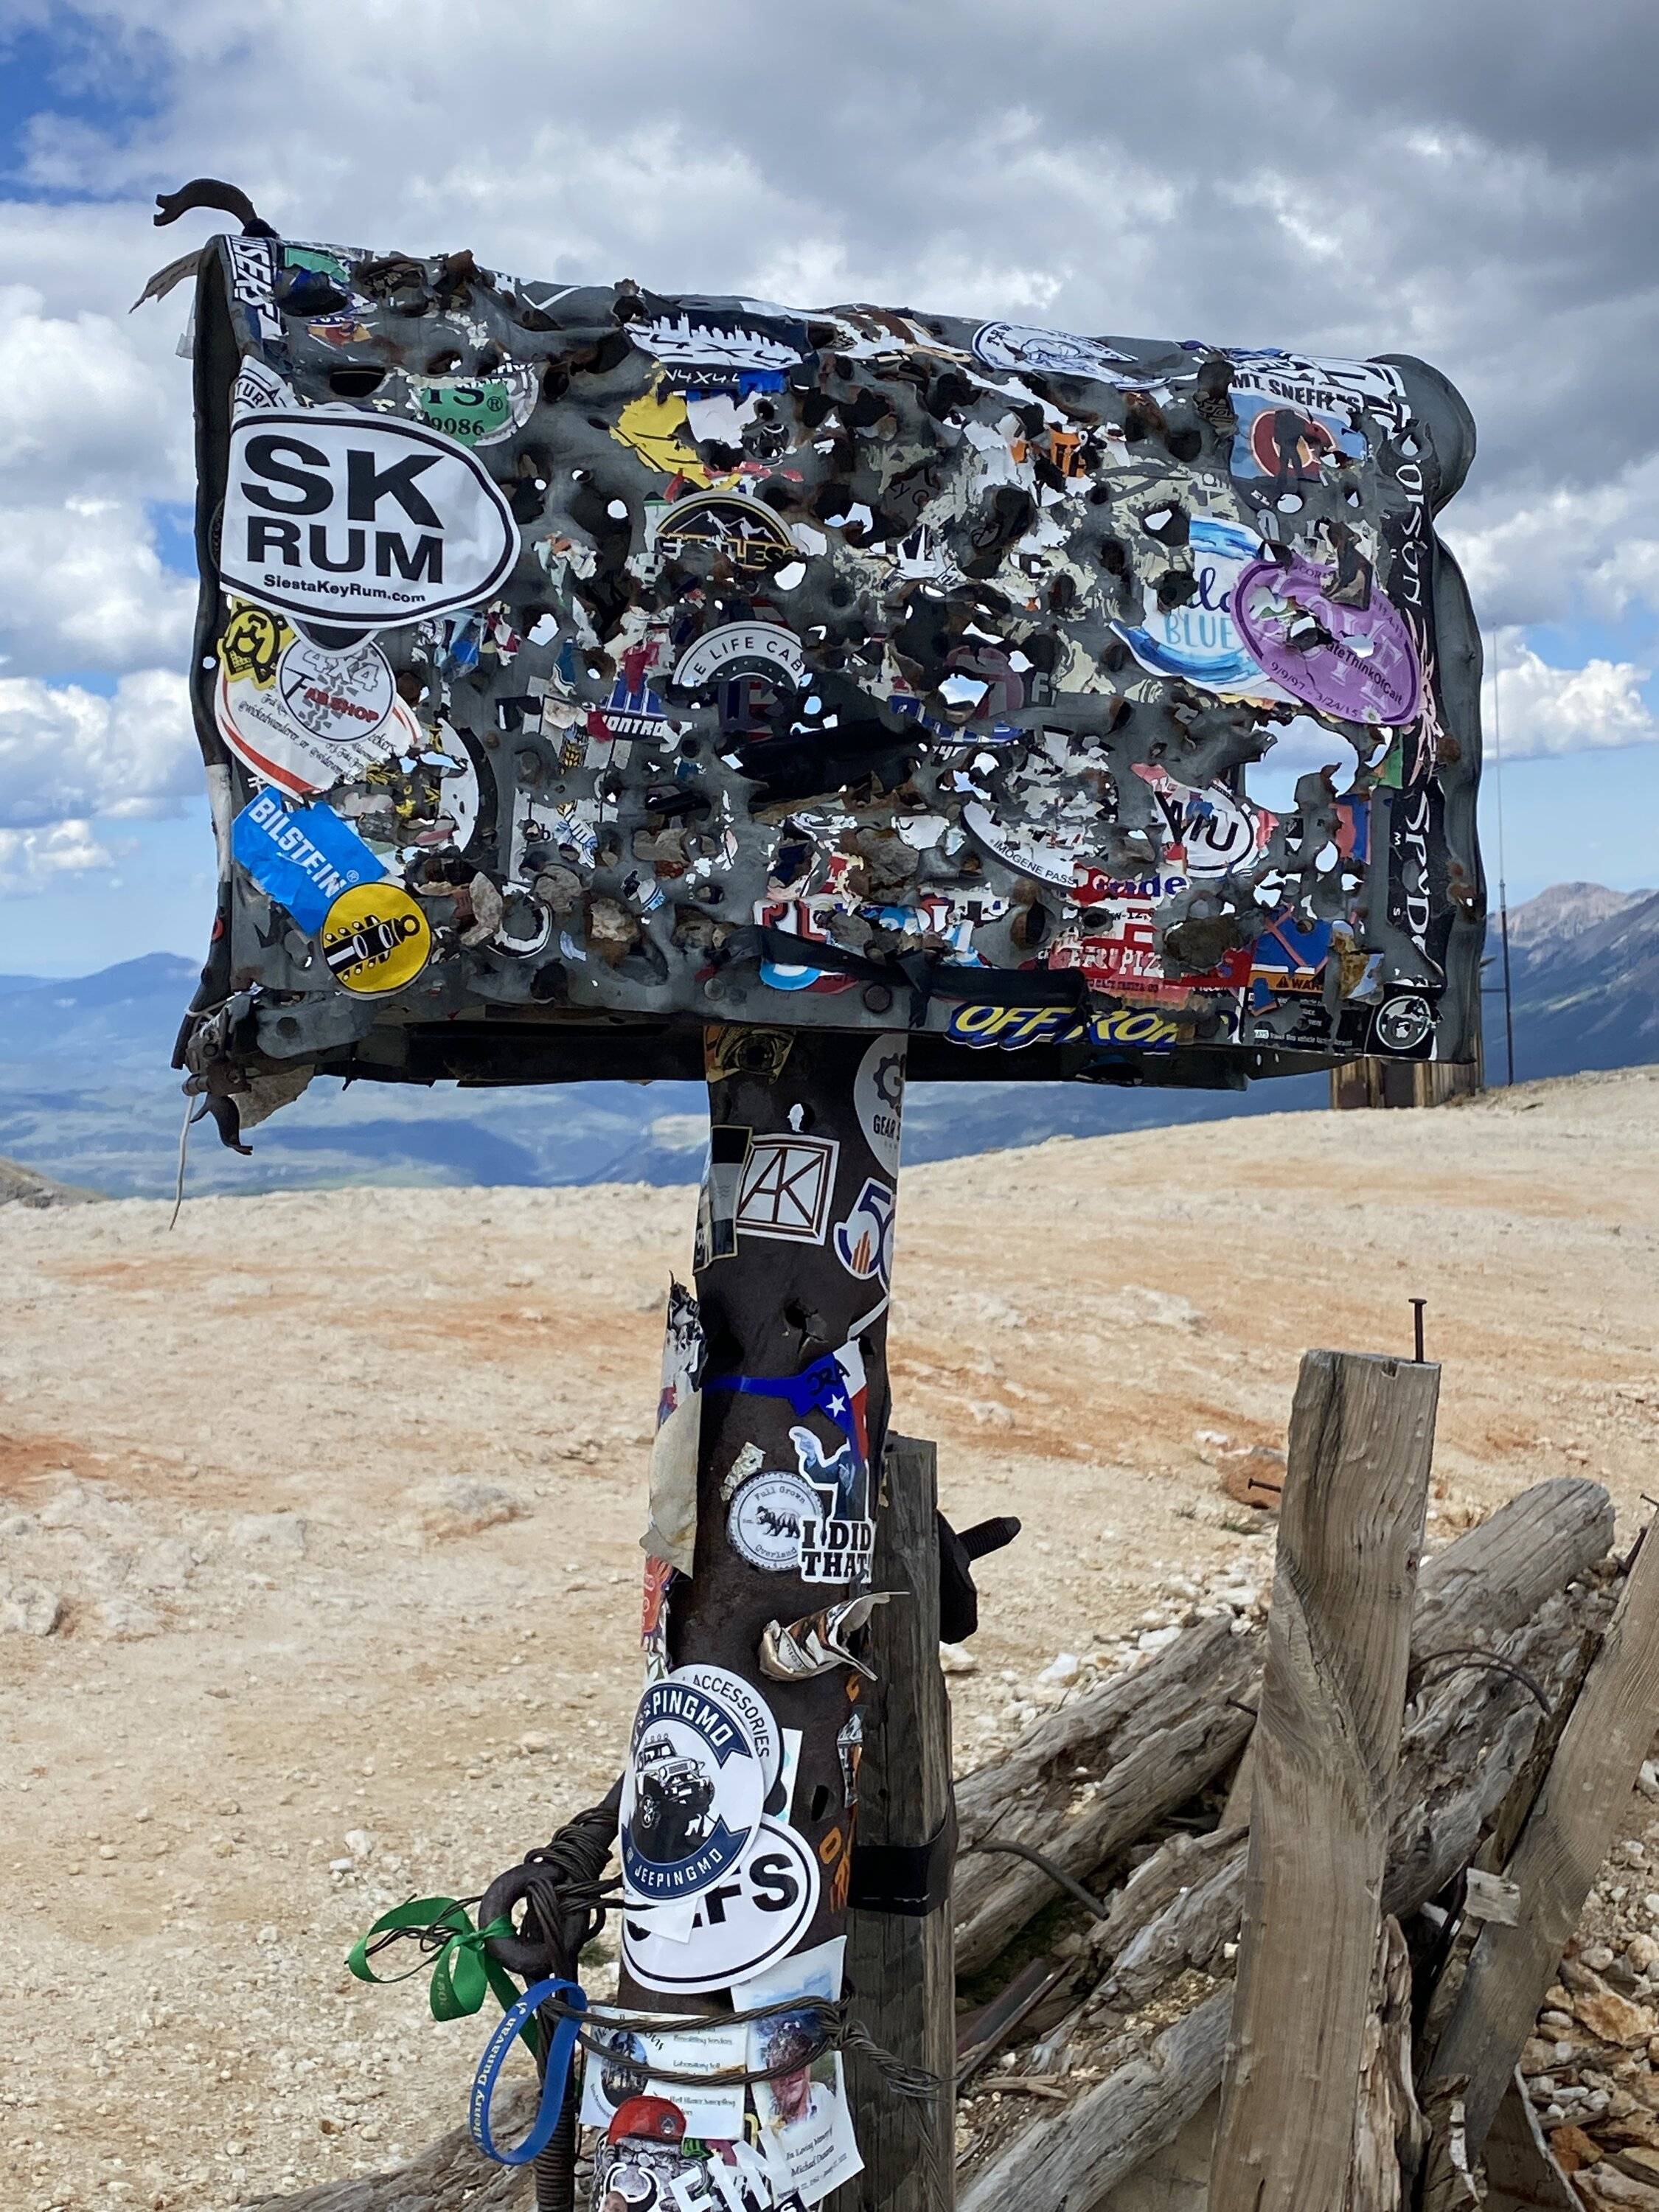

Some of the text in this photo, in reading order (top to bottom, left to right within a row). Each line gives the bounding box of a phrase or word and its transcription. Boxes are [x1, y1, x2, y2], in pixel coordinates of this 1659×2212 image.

[240, 434, 445, 530] SK
[246, 515, 445, 585] RUM
[264, 574, 426, 604] SiestaKeyRum.com
[1164, 613, 1236, 650] BLUE
[709, 636, 754, 661] LIFE
[330, 694, 380, 724] SHOP
[993, 840, 1075, 886] IMOGENE PASS
[956, 1005, 1077, 1037] OFF
[873, 1114, 895, 1139] GEAR
[755, 1486, 806, 1505] Full Grown
[801, 1520, 872, 1551] I DID
[755, 1544, 798, 1559] Overland
[693, 1674, 770, 1758] ACCESSORIES
[634, 1848, 723, 1888] JEEPINGMO
